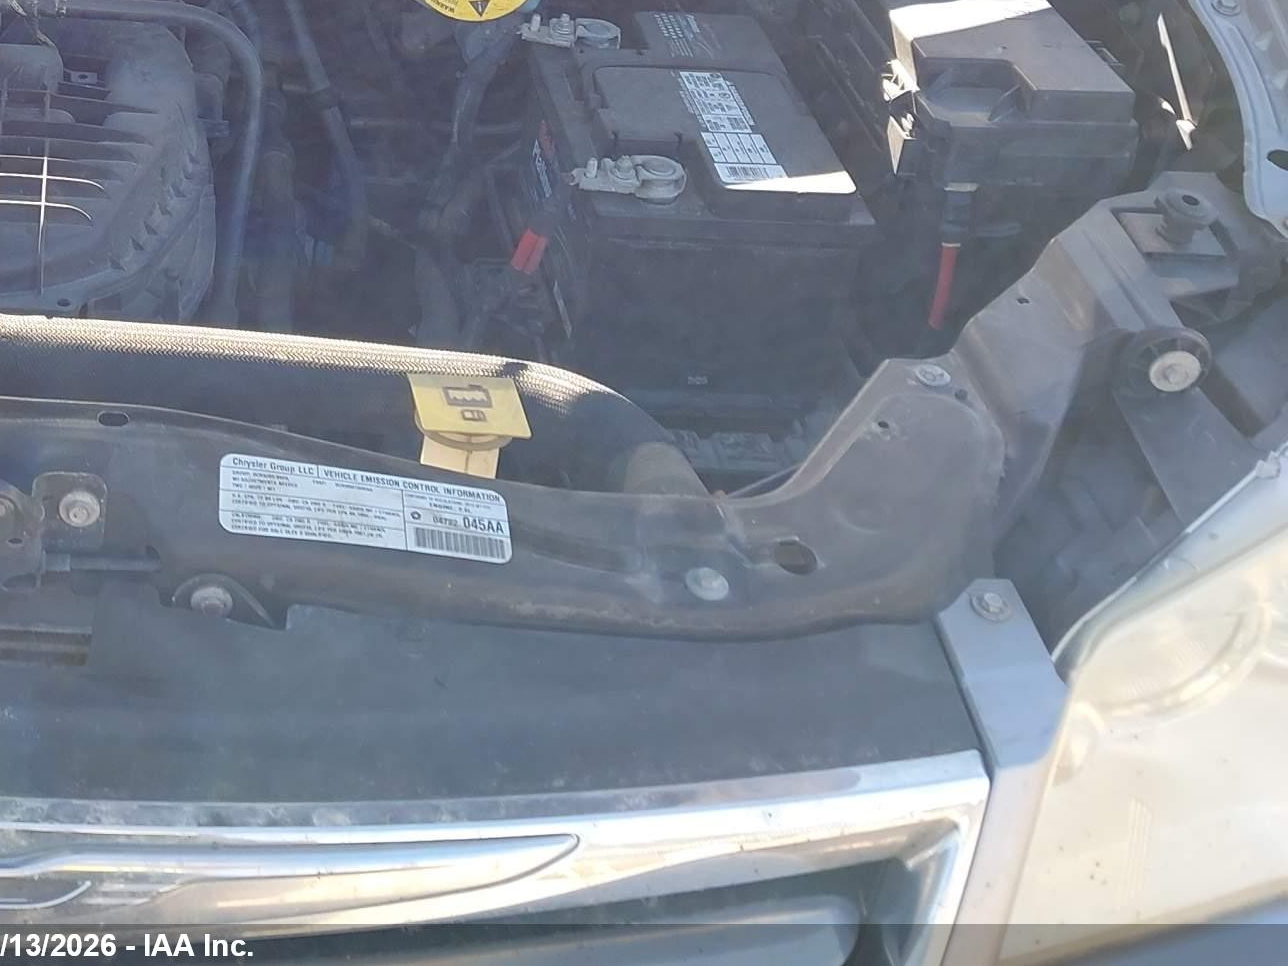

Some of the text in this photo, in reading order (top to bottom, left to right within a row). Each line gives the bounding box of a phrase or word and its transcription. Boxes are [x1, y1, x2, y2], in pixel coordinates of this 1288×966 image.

[232, 458, 268, 470] Chrysler
[270, 461, 296, 474] Group
[298, 466, 314, 475] LLC
[323, 469, 358, 482] VEHICLE
[361, 474, 400, 489] EMISSION
[402, 482, 441, 495] CONTROL
[443, 487, 500, 503] INFORMATION
[462, 517, 505, 535] 045AA
